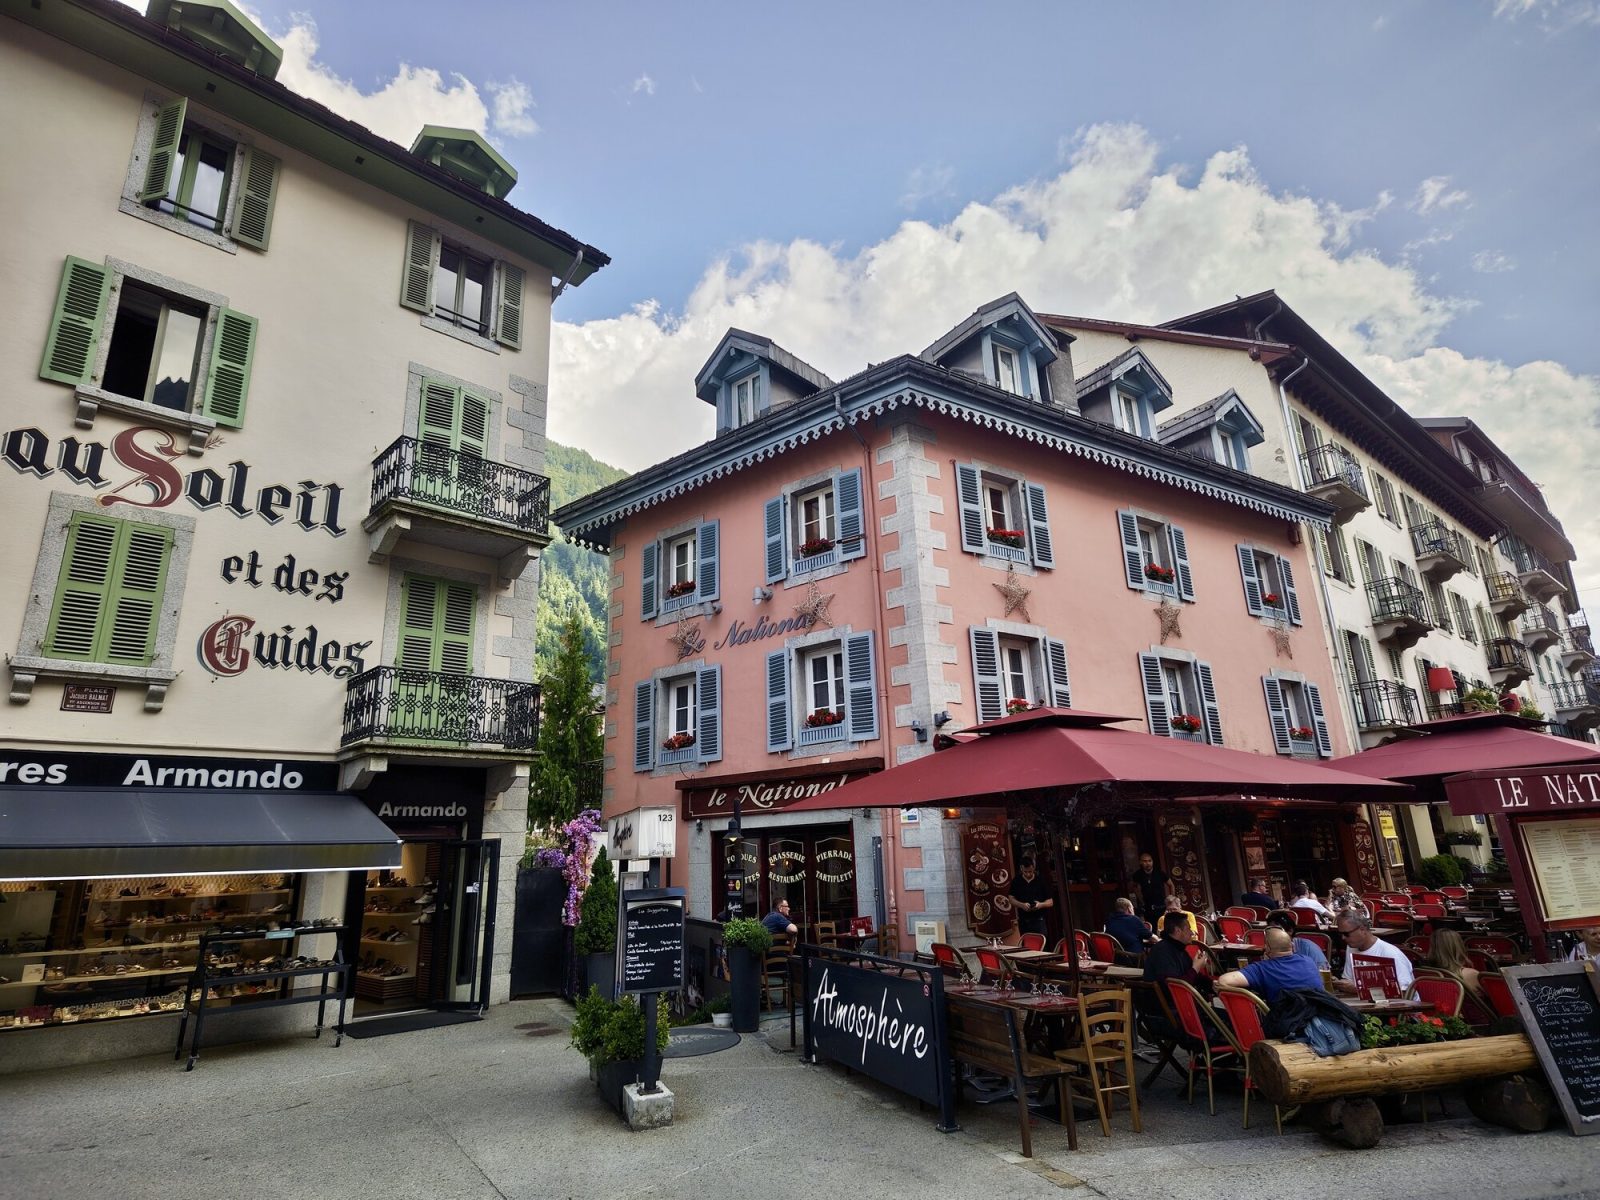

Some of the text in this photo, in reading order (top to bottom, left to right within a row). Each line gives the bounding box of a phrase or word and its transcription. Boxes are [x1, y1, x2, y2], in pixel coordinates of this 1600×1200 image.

[1, 426, 346, 538] au Soleil
[220, 549, 350, 604] et des
[197, 610, 373, 679] Guides
[0, 759, 303, 789] res Armando
[708, 788, 727, 807] le
[1495, 773, 1600, 807] LE NAT
[378, 801, 467, 817] Armando
[658, 814, 673, 822] 123
[727, 853, 757, 864] FODUES
[769, 851, 806, 864] BRASSERIE
[816, 849, 852, 862] PIERRADE
[768, 870, 806, 883] RESTAURANT
[816, 869, 853, 883] TARTIFLETT
[813, 967, 928, 1065] Atmosphère
